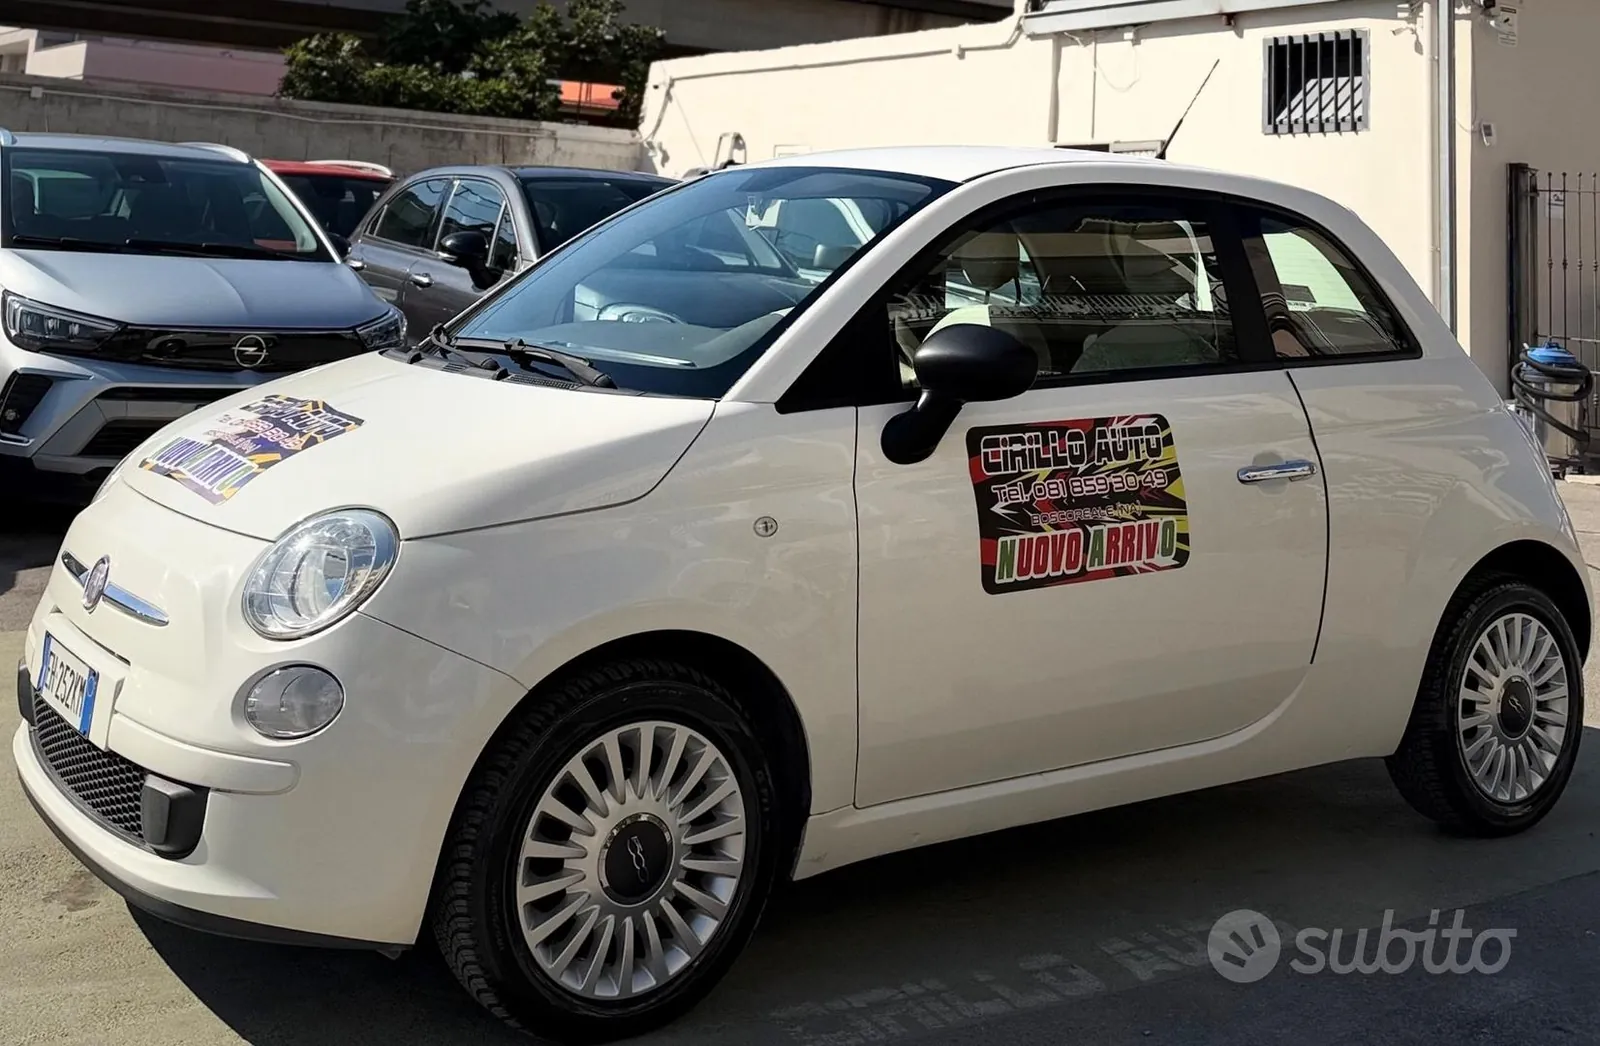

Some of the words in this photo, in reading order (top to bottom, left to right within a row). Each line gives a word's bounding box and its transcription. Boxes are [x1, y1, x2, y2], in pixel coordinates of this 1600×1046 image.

[1095, 423, 1163, 466] AUTO
[1033, 478, 1067, 500] 081
[1070, 473, 1109, 497] 859
[1111, 471, 1138, 492] 30
[1141, 469, 1168, 488] 49
[1031, 506, 1114, 525] BOSCOREALE
[995, 528, 1084, 583] NUOVO
[1086, 517, 1176, 571] ARRIVO
